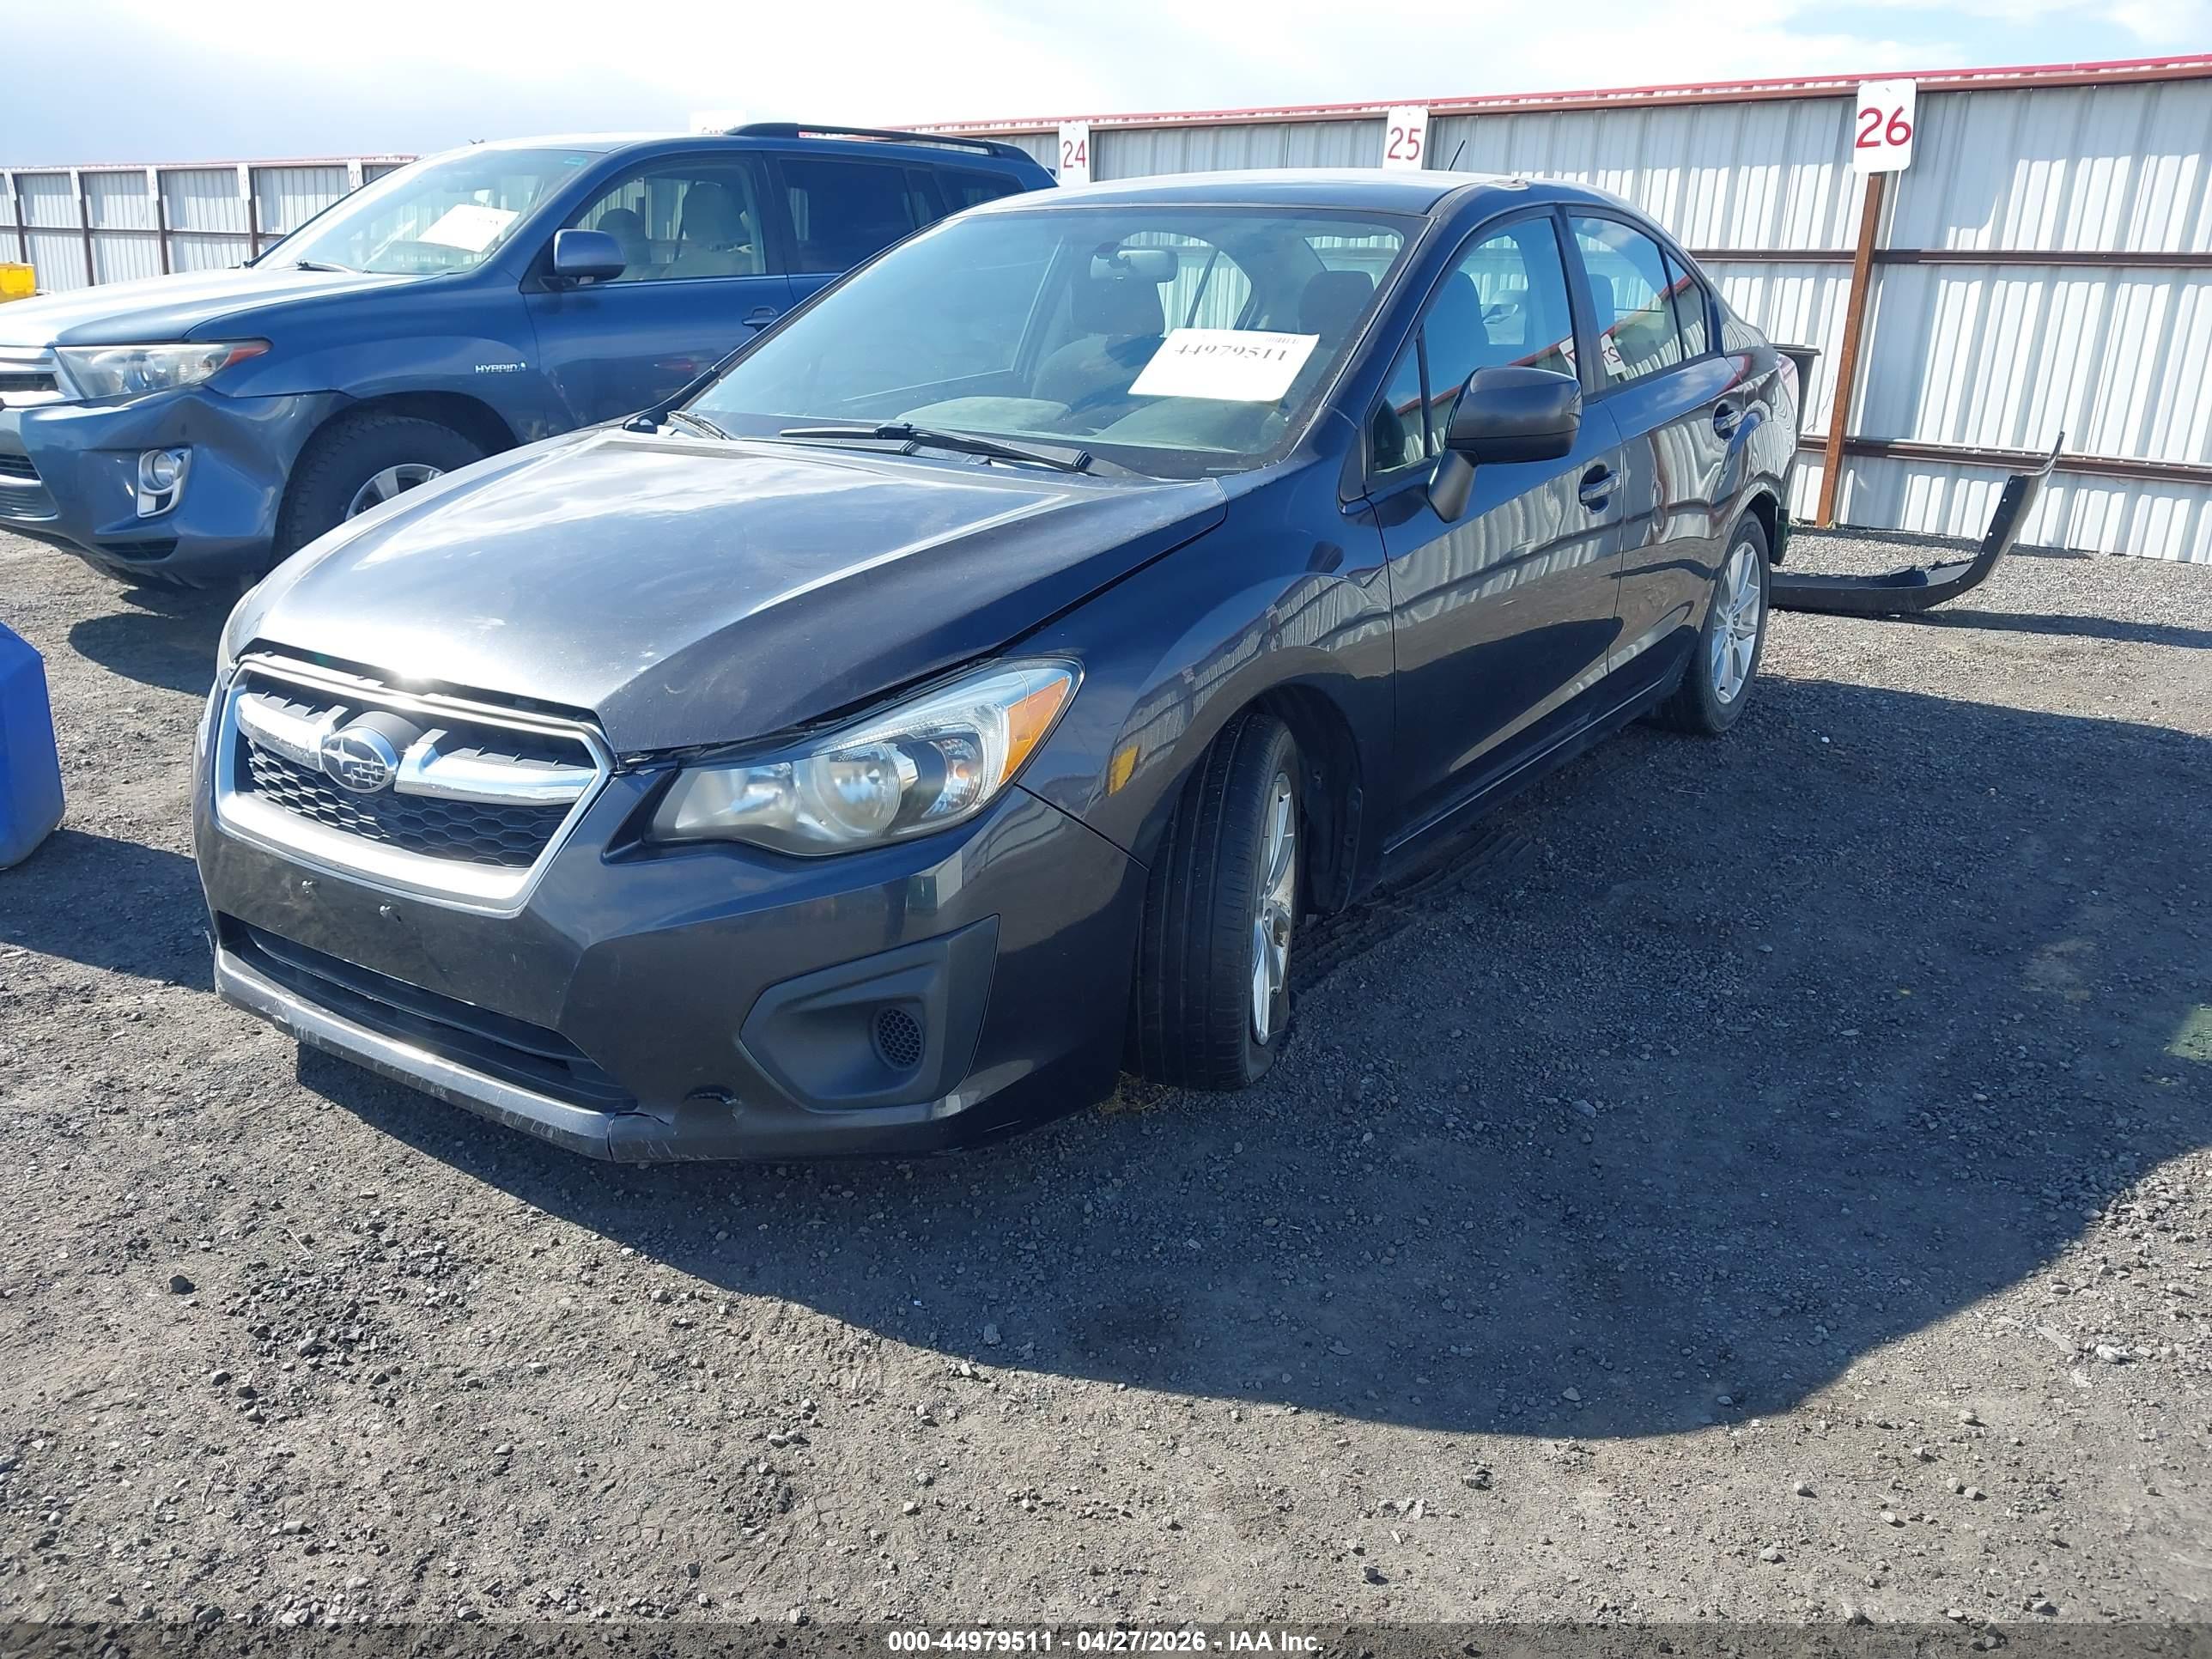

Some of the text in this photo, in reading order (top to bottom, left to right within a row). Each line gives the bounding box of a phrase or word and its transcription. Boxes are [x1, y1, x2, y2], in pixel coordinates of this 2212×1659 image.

[1387, 126, 1422, 161] 25
[1856, 106, 1912, 148] 26
[1062, 139, 1086, 169] 24
